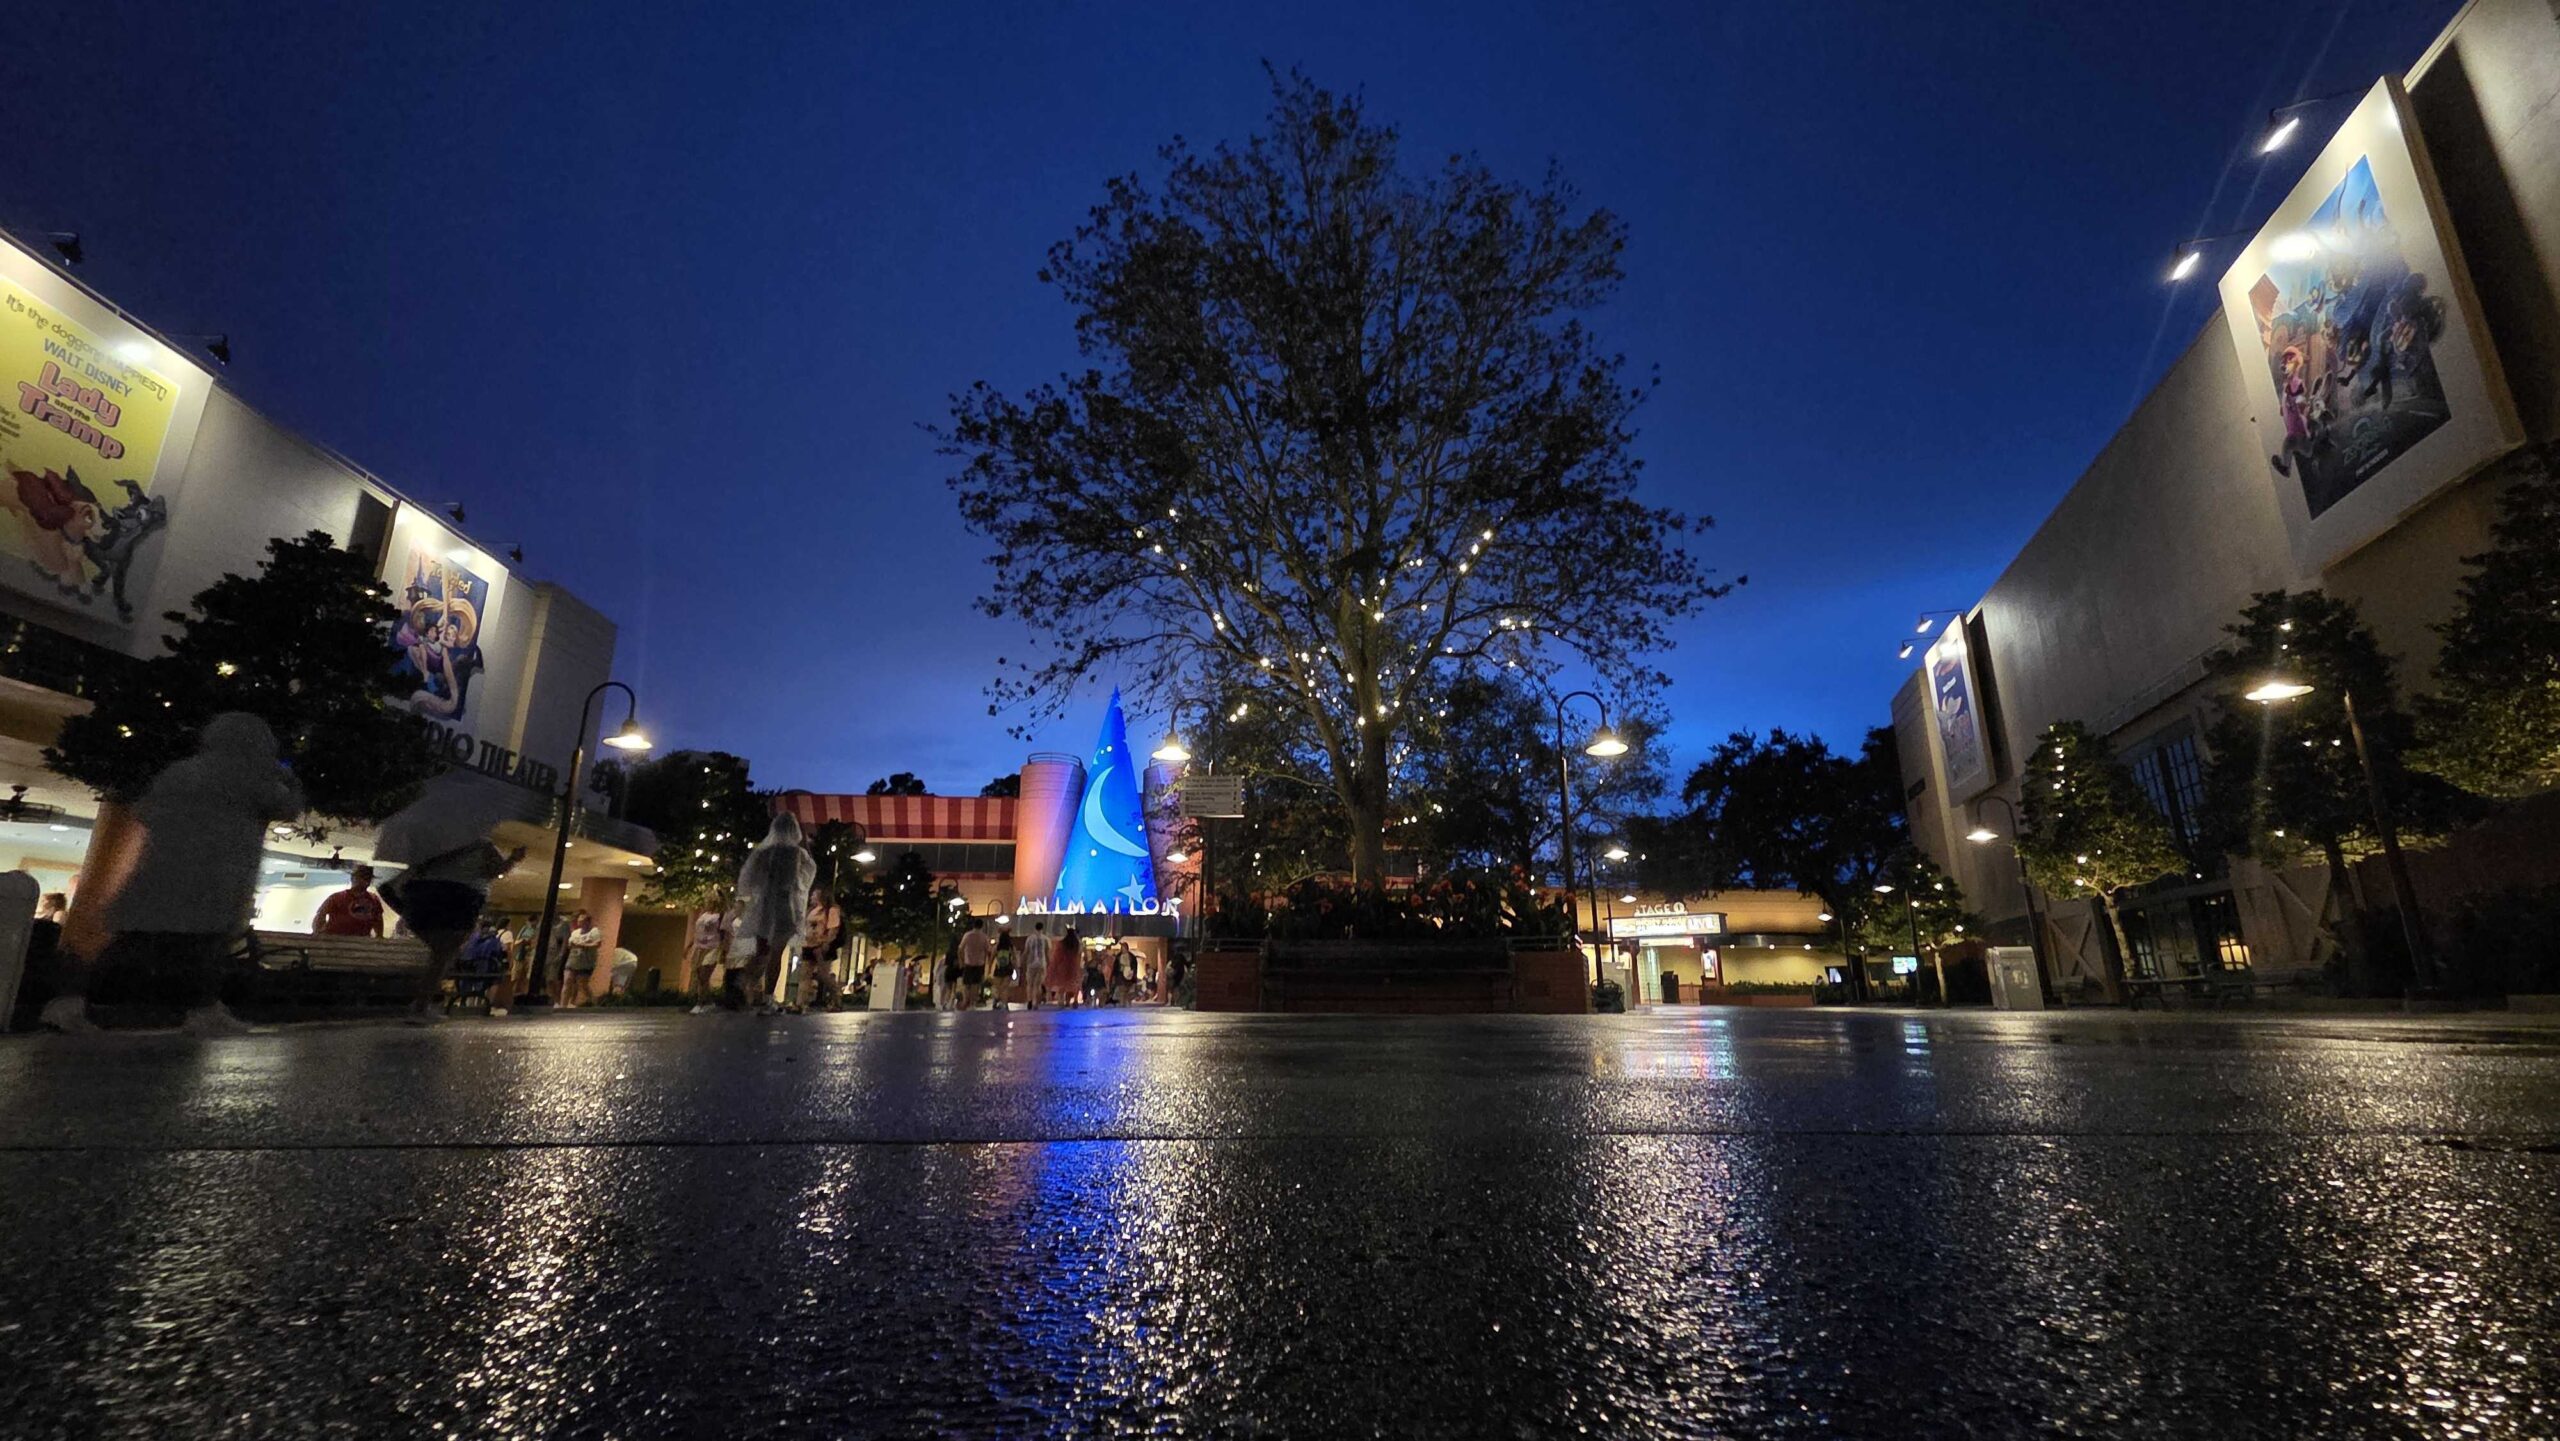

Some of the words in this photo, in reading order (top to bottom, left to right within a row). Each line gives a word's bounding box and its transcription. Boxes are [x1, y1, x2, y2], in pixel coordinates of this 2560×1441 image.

[6, 294, 25, 312] It's
[28, 307, 49, 329] the
[38, 360, 121, 428] Lady
[44, 338, 84, 369] WALT
[84, 362, 133, 398] DISNEY
[18, 380, 125, 459] Tramp
[54, 398, 73, 411] and
[478, 739, 558, 797] THEATER
[1016, 895, 1180, 918] ANIMATION
